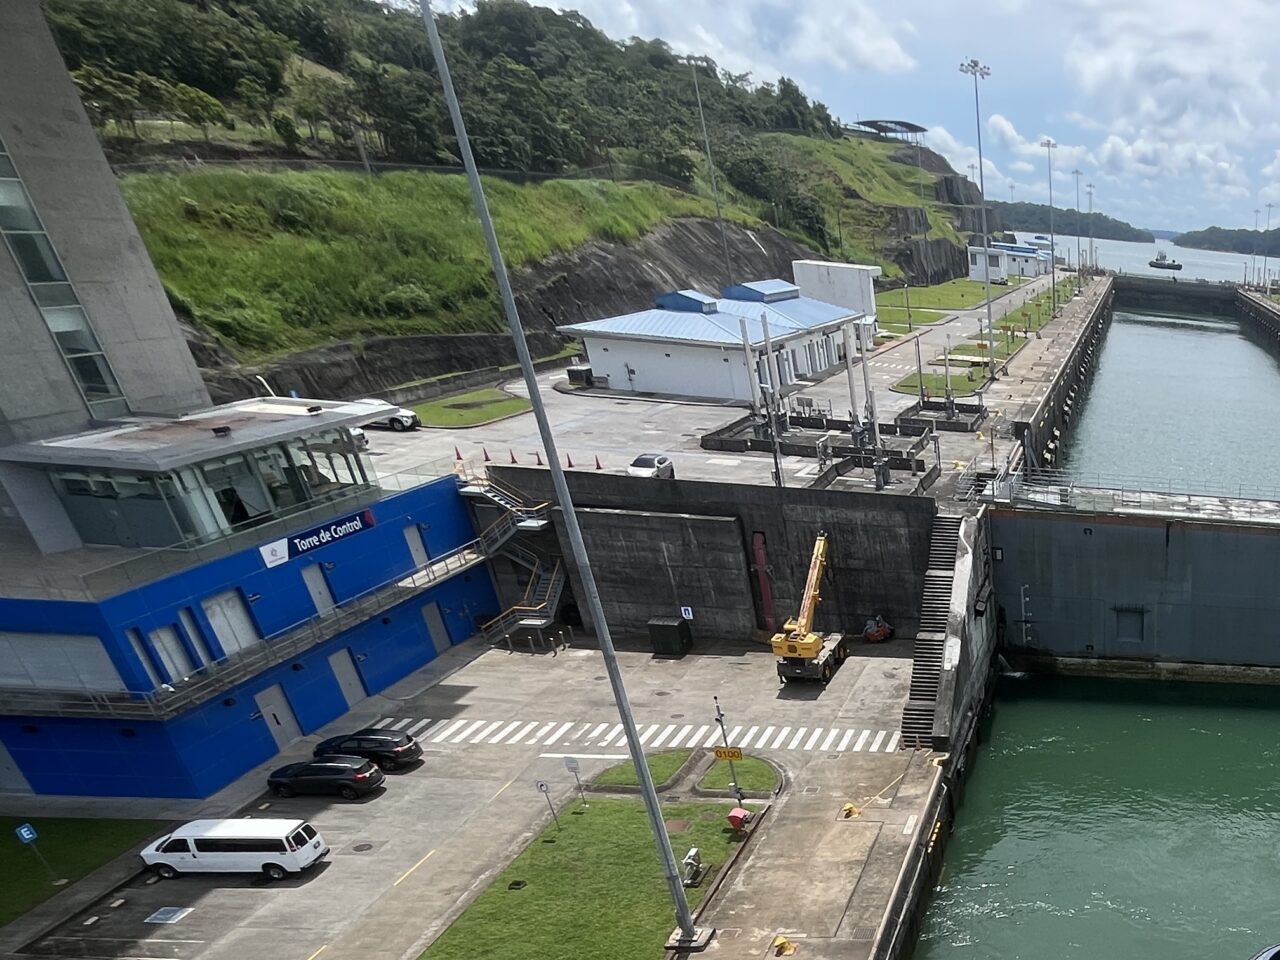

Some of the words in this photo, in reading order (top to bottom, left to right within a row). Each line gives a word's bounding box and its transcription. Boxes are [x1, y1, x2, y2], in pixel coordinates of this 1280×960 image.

[293, 537, 320, 552] Torre
[320, 530, 333, 543] de
[331, 516, 363, 538] Control
[715, 749, 740, 759] 0100
[20, 827, 33, 839] E
